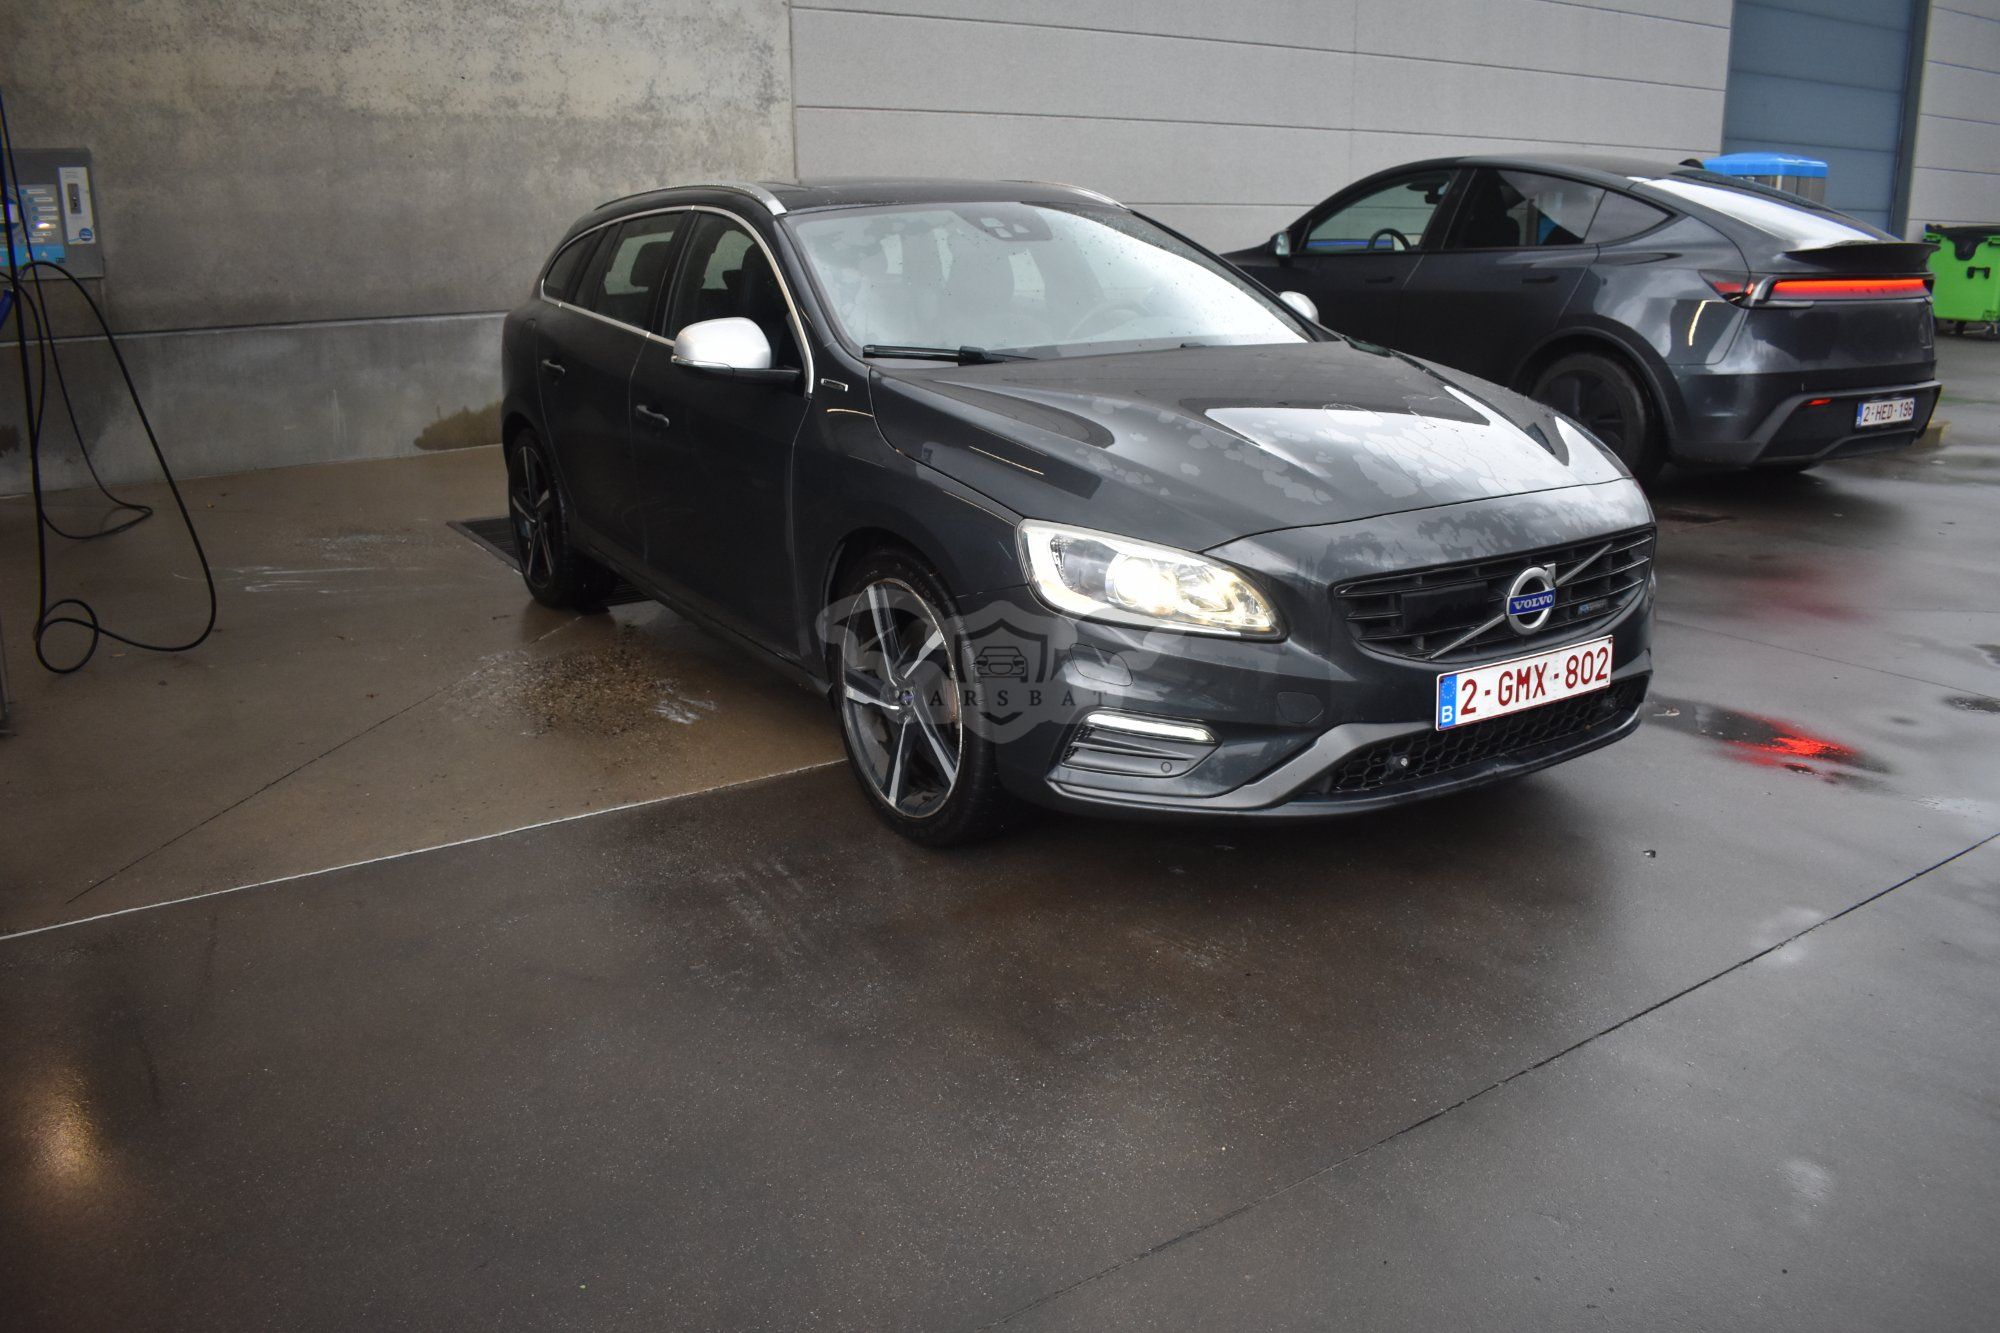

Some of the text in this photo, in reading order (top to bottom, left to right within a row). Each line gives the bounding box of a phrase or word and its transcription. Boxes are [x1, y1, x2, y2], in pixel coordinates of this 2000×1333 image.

[1513, 594, 1553, 610] VOLVO
[1441, 646, 1609, 722] B 2-GMX-802
